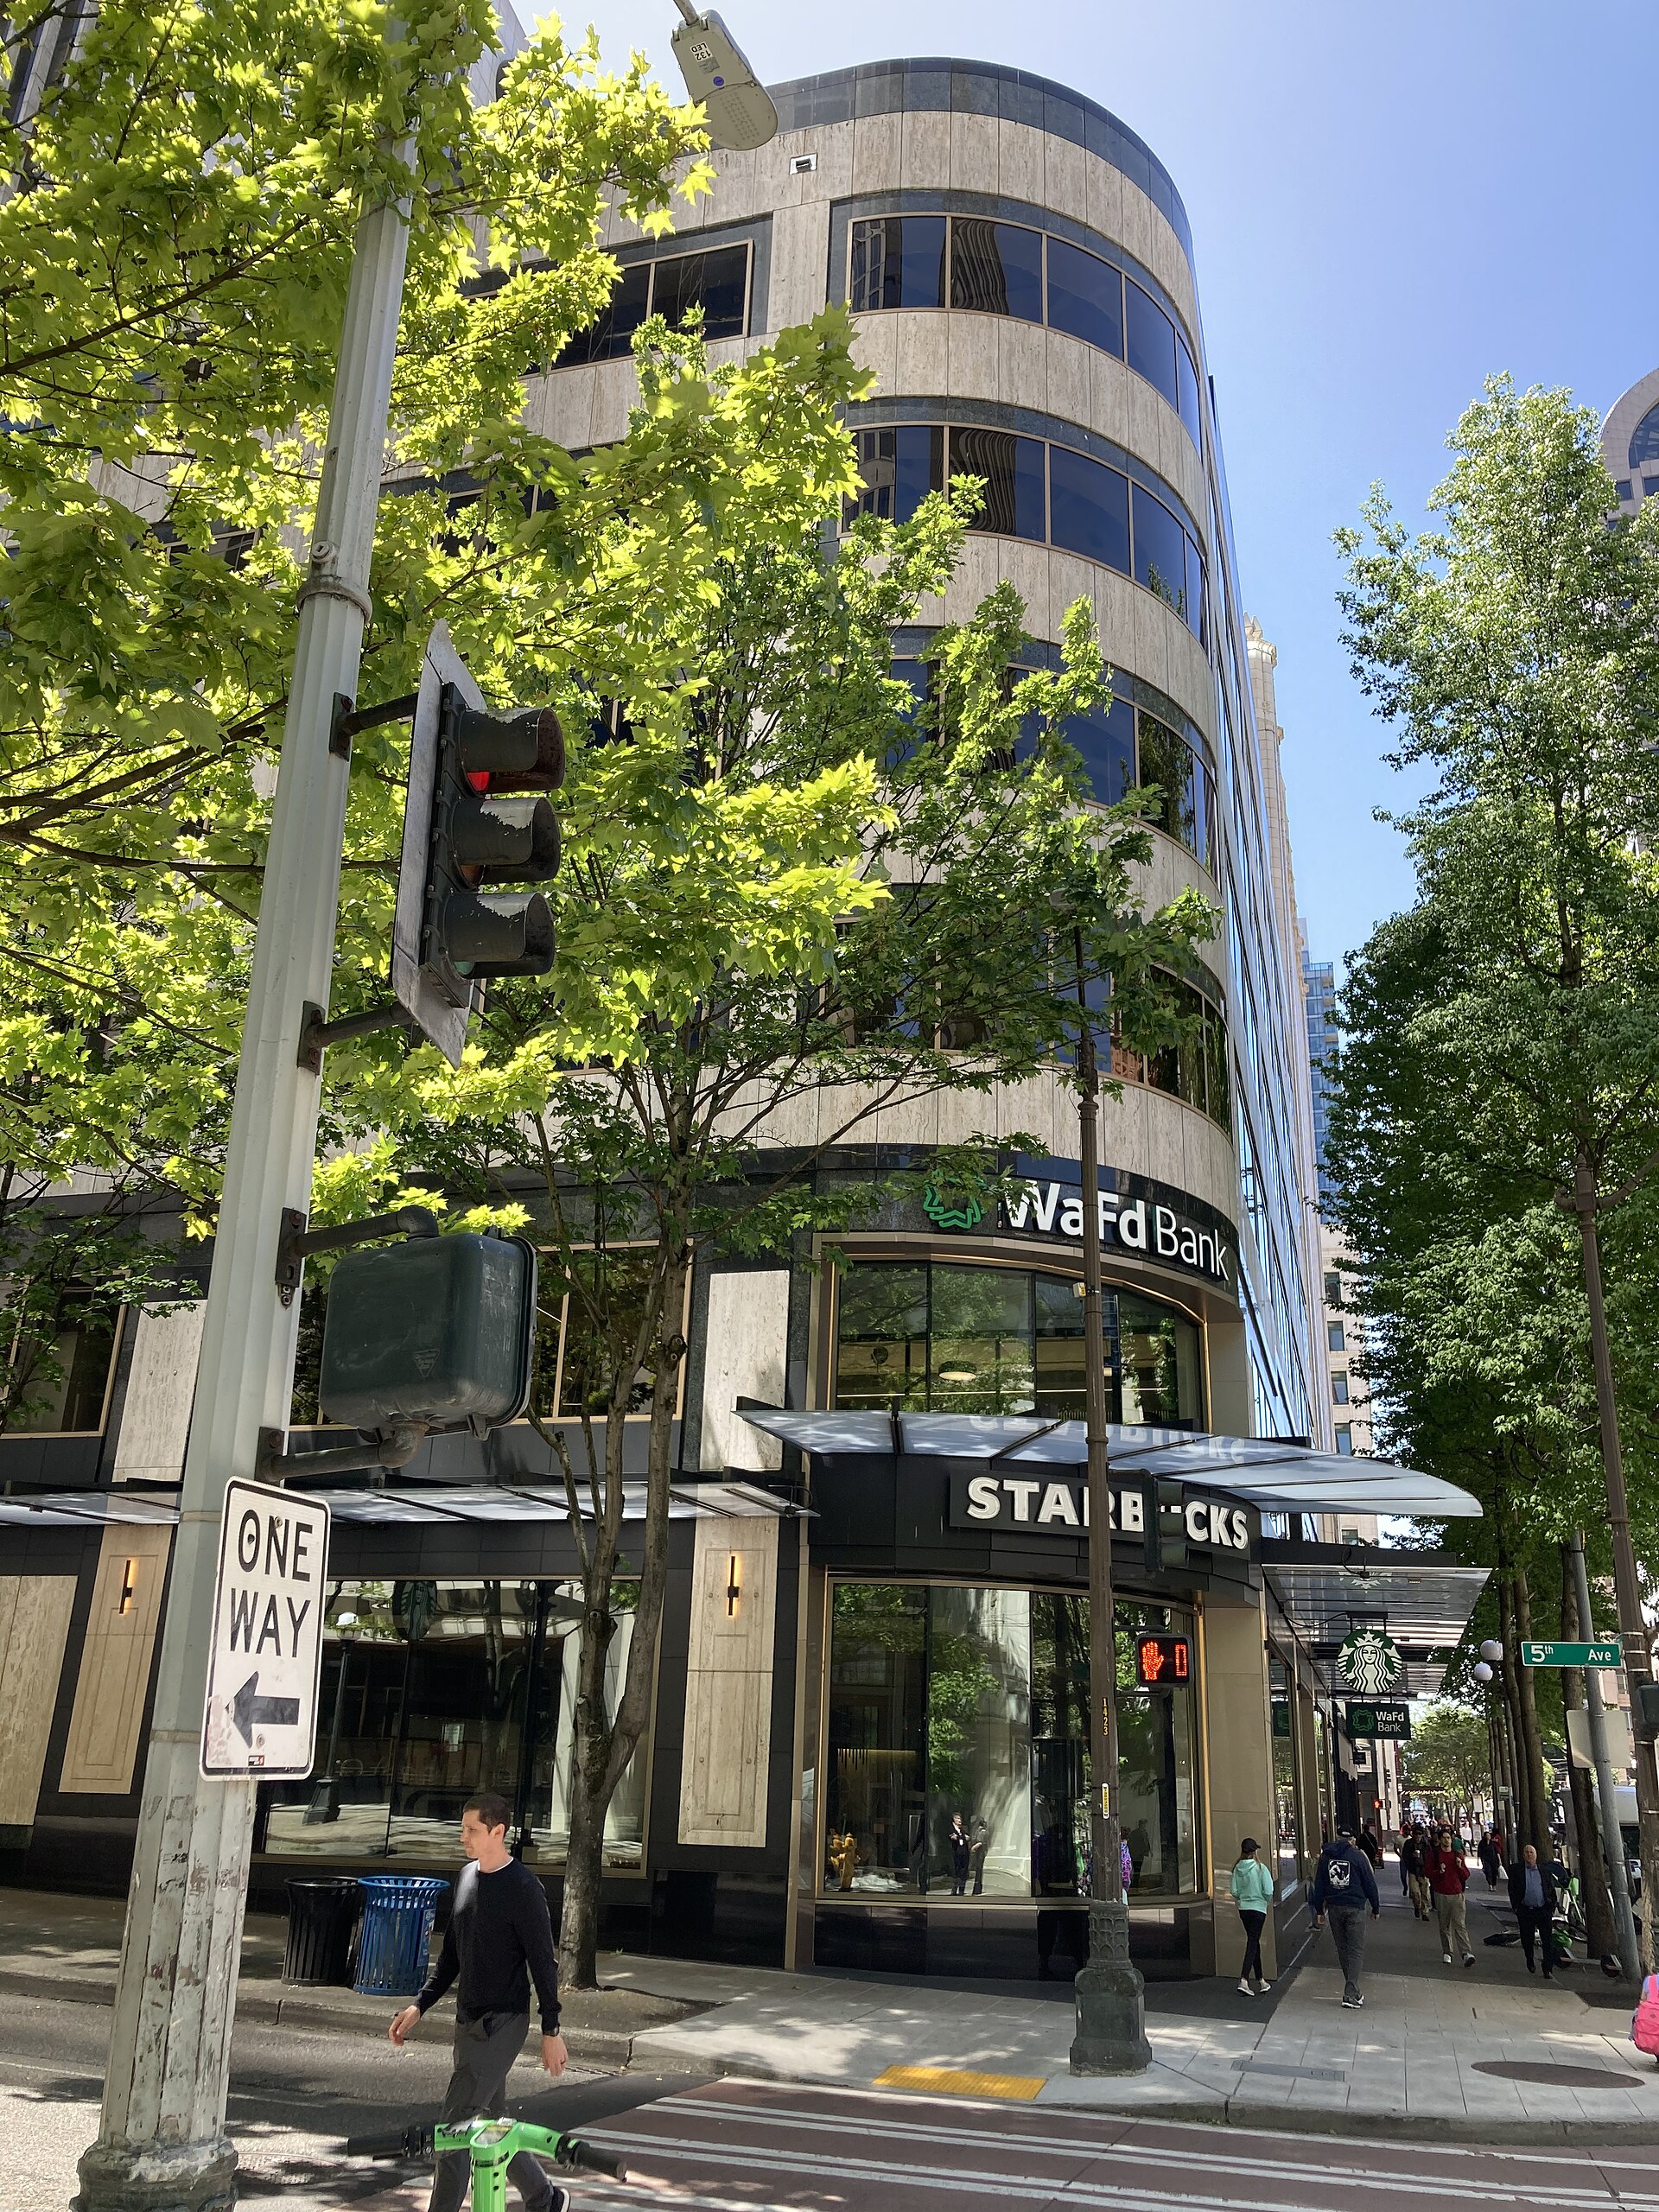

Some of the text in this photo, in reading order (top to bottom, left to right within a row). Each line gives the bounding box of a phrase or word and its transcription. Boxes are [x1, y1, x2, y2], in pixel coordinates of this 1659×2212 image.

[691, 42, 708, 53] LED
[694, 50, 711, 60] 132
[1002, 1176, 1230, 1281] WaFd Bank
[966, 1477, 1249, 1550] STABCKS
[238, 1509, 314, 1582] ONE
[229, 1587, 312, 1658] WAY
[1530, 1644, 1611, 1662] 5th Ave
[1375, 1711, 1404, 1722] WaFd
[1377, 1722, 1402, 1732] Bank
